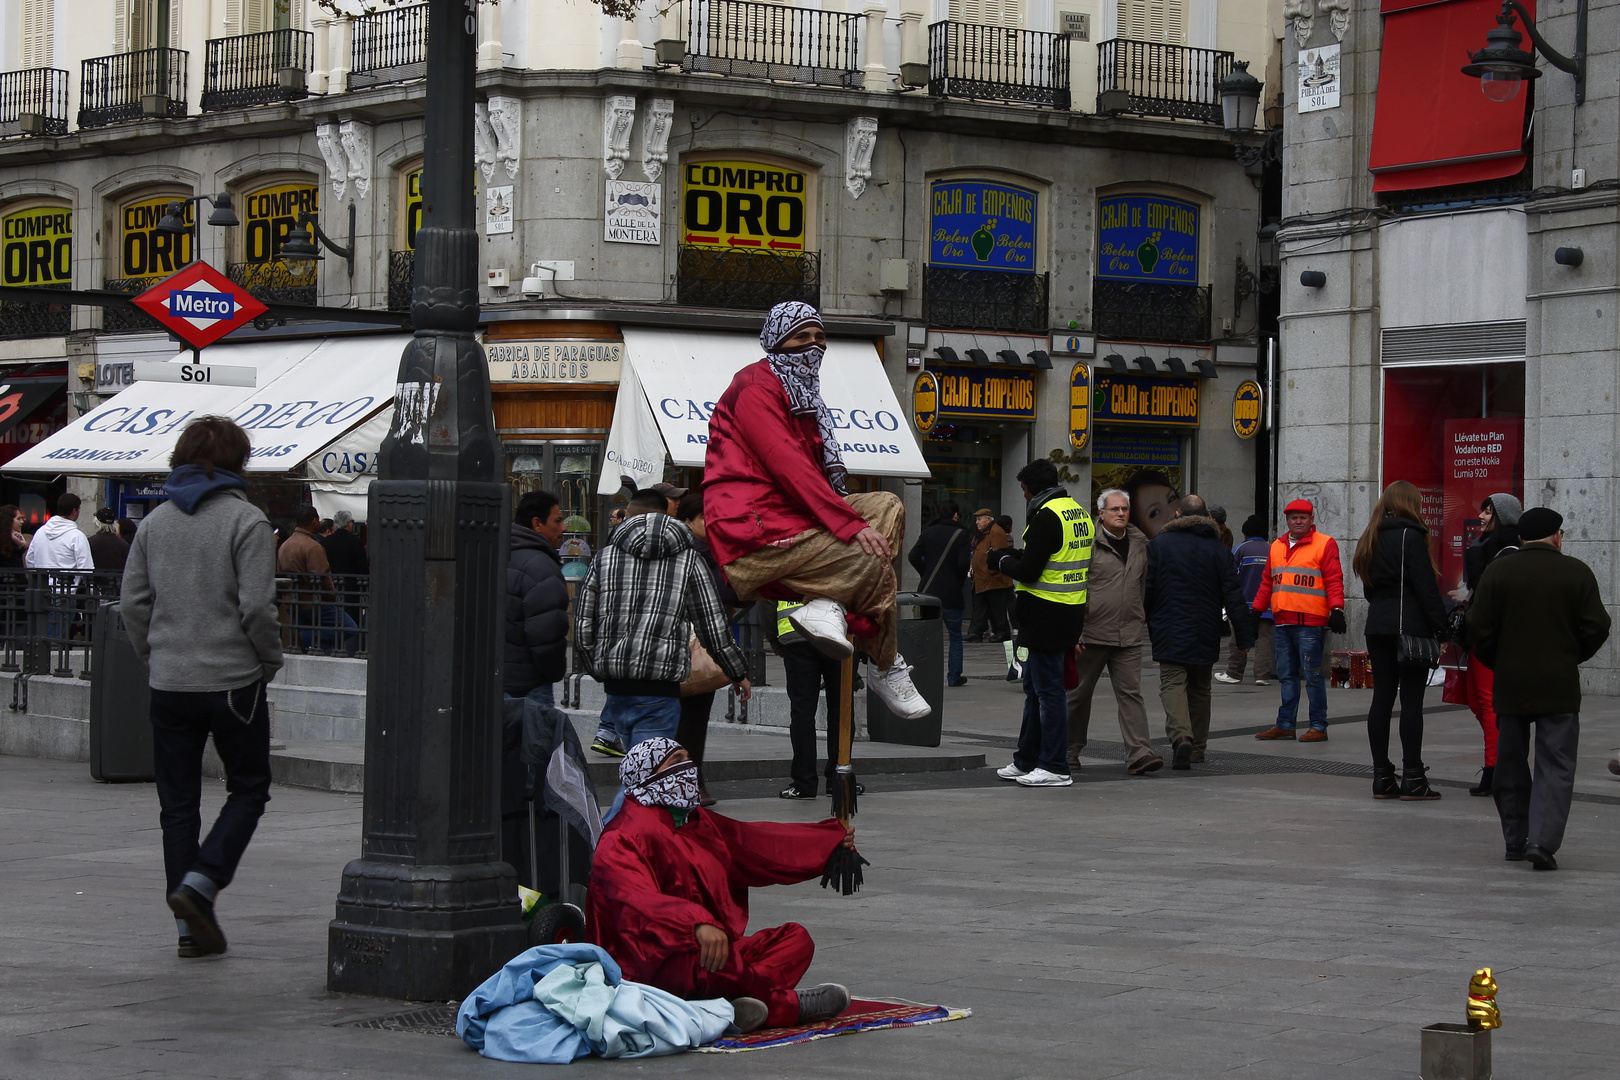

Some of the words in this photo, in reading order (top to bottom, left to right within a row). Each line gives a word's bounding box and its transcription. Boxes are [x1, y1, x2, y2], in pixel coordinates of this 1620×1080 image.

[1064, 30, 1087, 38] NTERA
[1301, 86, 1324, 97] PUERTA
[1312, 96, 1326, 106] SOL
[686, 165, 803, 193] COMPRO
[685, 189, 803, 237] ORO
[934, 189, 962, 216] CAJA
[966, 193, 976, 214] DE
[982, 189, 1032, 223] EMPEÑOS
[4, 213, 72, 239] COMPRO
[609, 218, 636, 228] CALLE
[1101, 203, 1128, 229] CAJA
[1132, 207, 1141, 227] DE
[1147, 203, 1194, 236] EMPEÑOS
[247, 213, 318, 263] OR
[608, 228, 658, 242] MONTERA
[933, 229, 969, 243] Belen
[997, 234, 1032, 248] Belen
[124, 229, 194, 276] ORO
[942, 243, 964, 257] Oro
[1005, 249, 1026, 262] Oro
[1101, 243, 1135, 257] Belen
[1161, 247, 1194, 261] Belen
[4, 237, 72, 284] ORO
[1109, 257, 1130, 270] Oro
[1169, 261, 1189, 274] Oro
[176, 294, 230, 314] Metro
[1070, 338, 1077, 350] 1
[488, 346, 529, 362] FABRICA
[534, 346, 549, 361] DE
[554, 346, 619, 361] PARAGUAS
[181, 365, 211, 382] Sol
[511, 363, 588, 378] ABANICOS
[942, 376, 969, 407] CAJA
[971, 383, 982, 408] DE
[984, 376, 1033, 410] EMPEÑOS
[1111, 384, 1137, 414] CAJA
[1139, 391, 1149, 415] DE
[1151, 384, 1197, 417] EMPEÑOS
[84, 407, 195, 436] CASA
[233, 396, 374, 429] DIEGO
[660, 398, 718, 421] CAS
[828, 408, 899, 432] EGO
[1235, 400, 1258, 419] ORO
[1454, 433, 1480, 443] Llévate
[1480, 433, 1488, 441] tu
[1489, 432, 1504, 440] Plan
[41, 448, 149, 461] ABANICOS
[838, 443, 900, 454] RAGUAS
[1101, 451, 1150, 460] AUTORIZACIÓN
[1454, 445, 1486, 454] Vodafone
[1487, 444, 1502, 453] RED
[322, 452, 379, 474] CASA
[632, 459, 653, 473] DIEGO
[1454, 458, 1466, 467] con
[1467, 457, 1480, 466] este
[1481, 456, 1500, 465] Nokia
[1454, 469, 1474, 478] Lumia
[1474, 469, 1488, 477] 920
[1428, 506, 1444, 514] Inte
[1423, 516, 1438, 525] óvil
[1073, 522, 1088, 537] ORO
[1294, 574, 1315, 587] ORO
